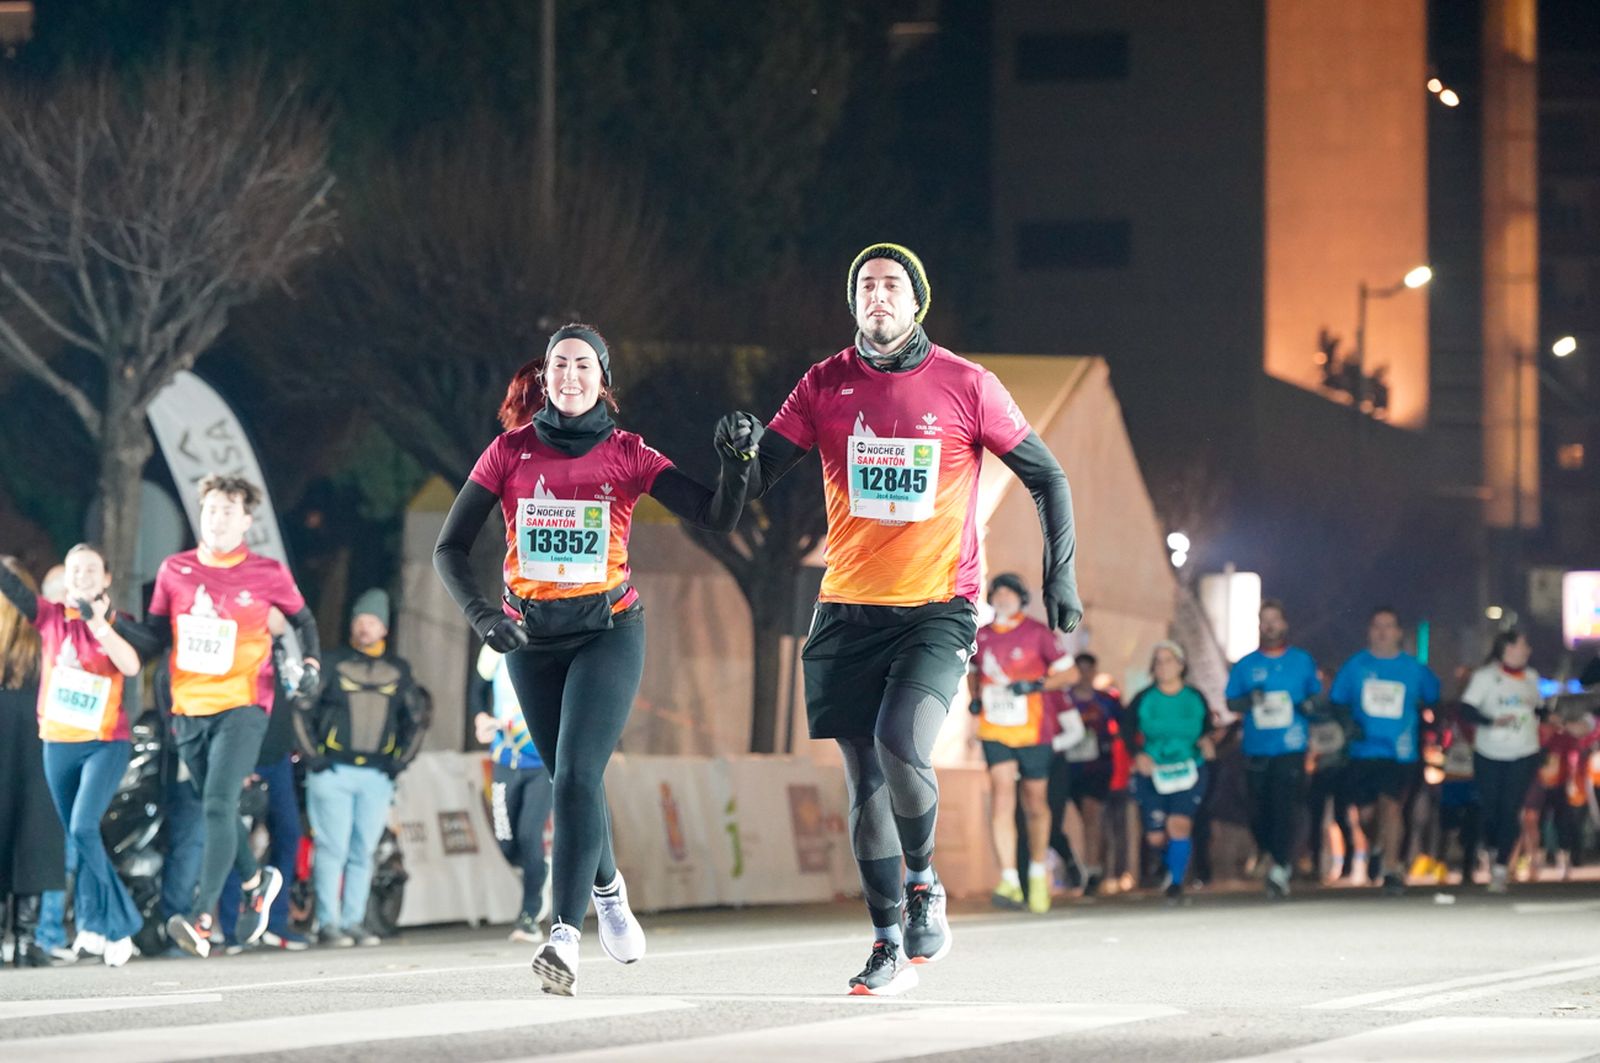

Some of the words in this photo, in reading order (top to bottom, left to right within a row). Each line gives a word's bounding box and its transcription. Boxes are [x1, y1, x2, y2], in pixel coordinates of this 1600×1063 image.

[867, 447, 893, 455] NOCHE
[895, 447, 905, 456] DE
[857, 455, 874, 464] SAN
[876, 455, 905, 466] ANTÓN
[859, 467, 927, 493] 12845
[536, 508, 563, 517] NOCHE
[565, 509, 576, 517] DE
[526, 517, 544, 527] SAN
[545, 517, 576, 528] ANTÓN
[527, 529, 598, 554] 13352
